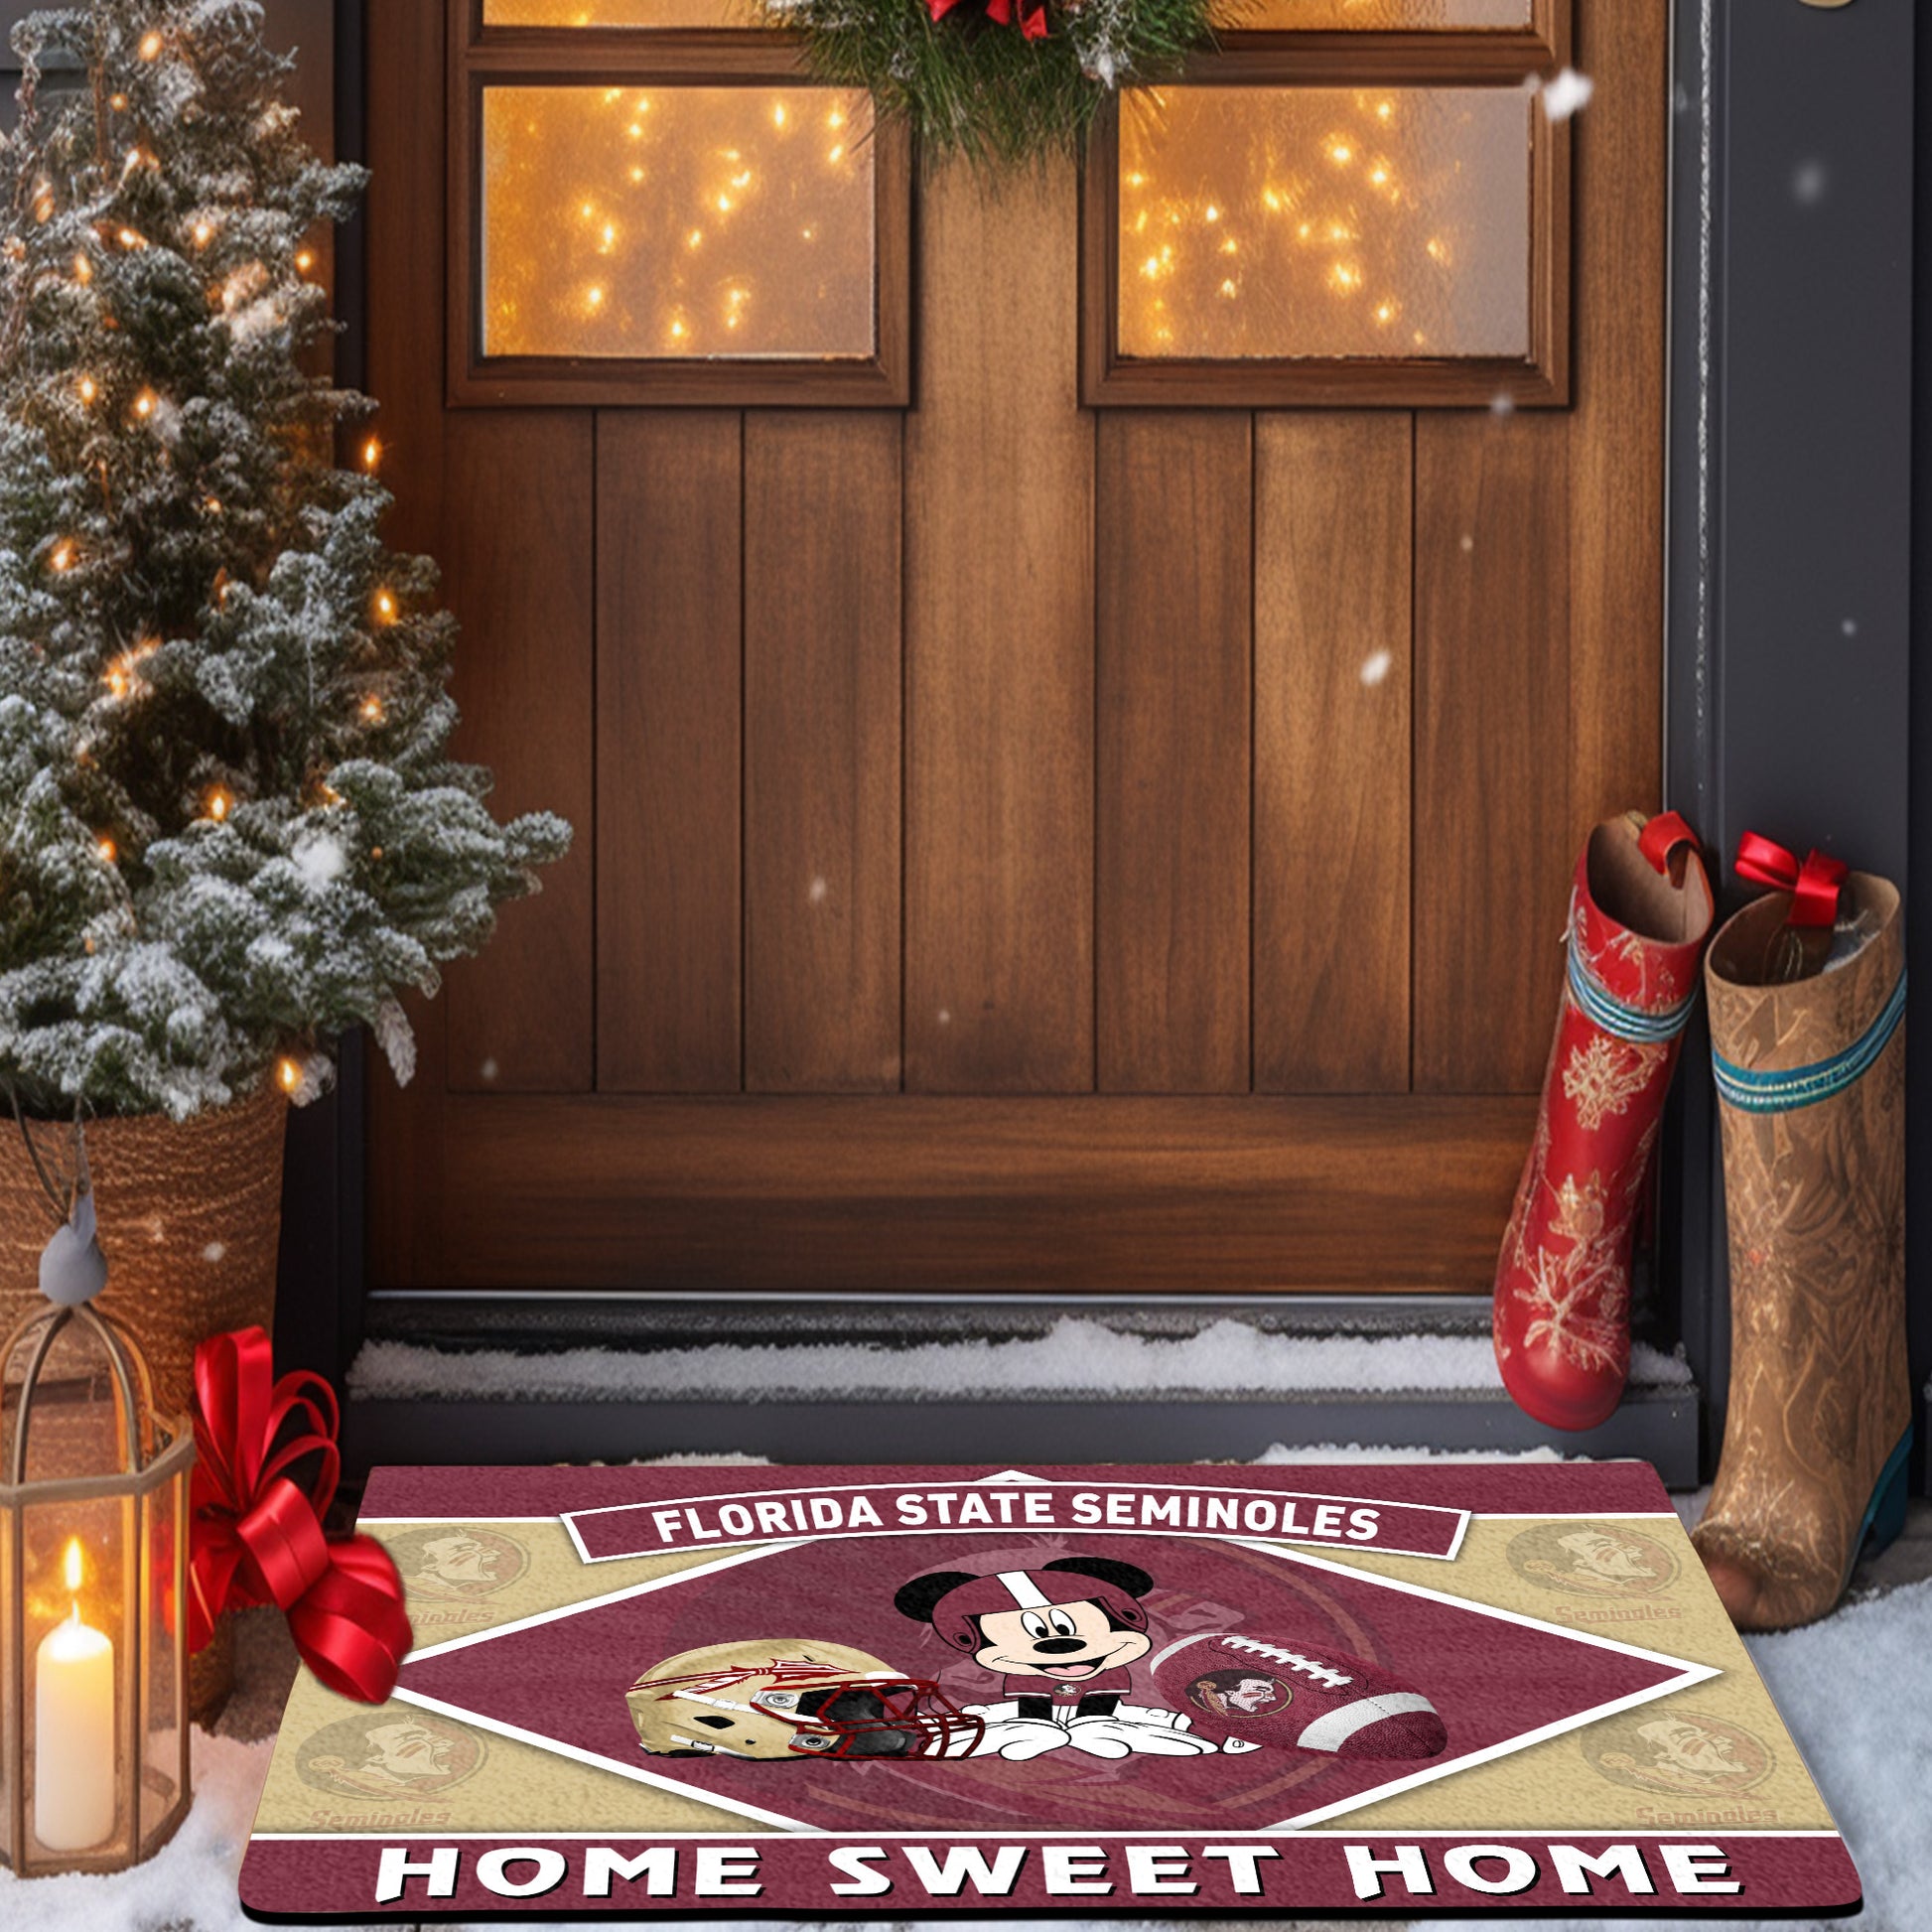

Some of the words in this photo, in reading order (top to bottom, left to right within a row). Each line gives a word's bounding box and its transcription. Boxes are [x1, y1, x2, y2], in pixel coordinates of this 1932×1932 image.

[651, 1494, 885, 1543] FLORIDA
[896, 1492, 1055, 1524] STATE
[1071, 1492, 1381, 1542] SEMINOLES
[1554, 1603, 1683, 1624] Seminoles
[304, 1808, 453, 1831] Seminoles
[1635, 1805, 1779, 1828] Seminoles
[374, 1846, 765, 1905] HOME
[828, 1845, 1283, 1896] SWEET
[1342, 1844, 1743, 1902] HOME
